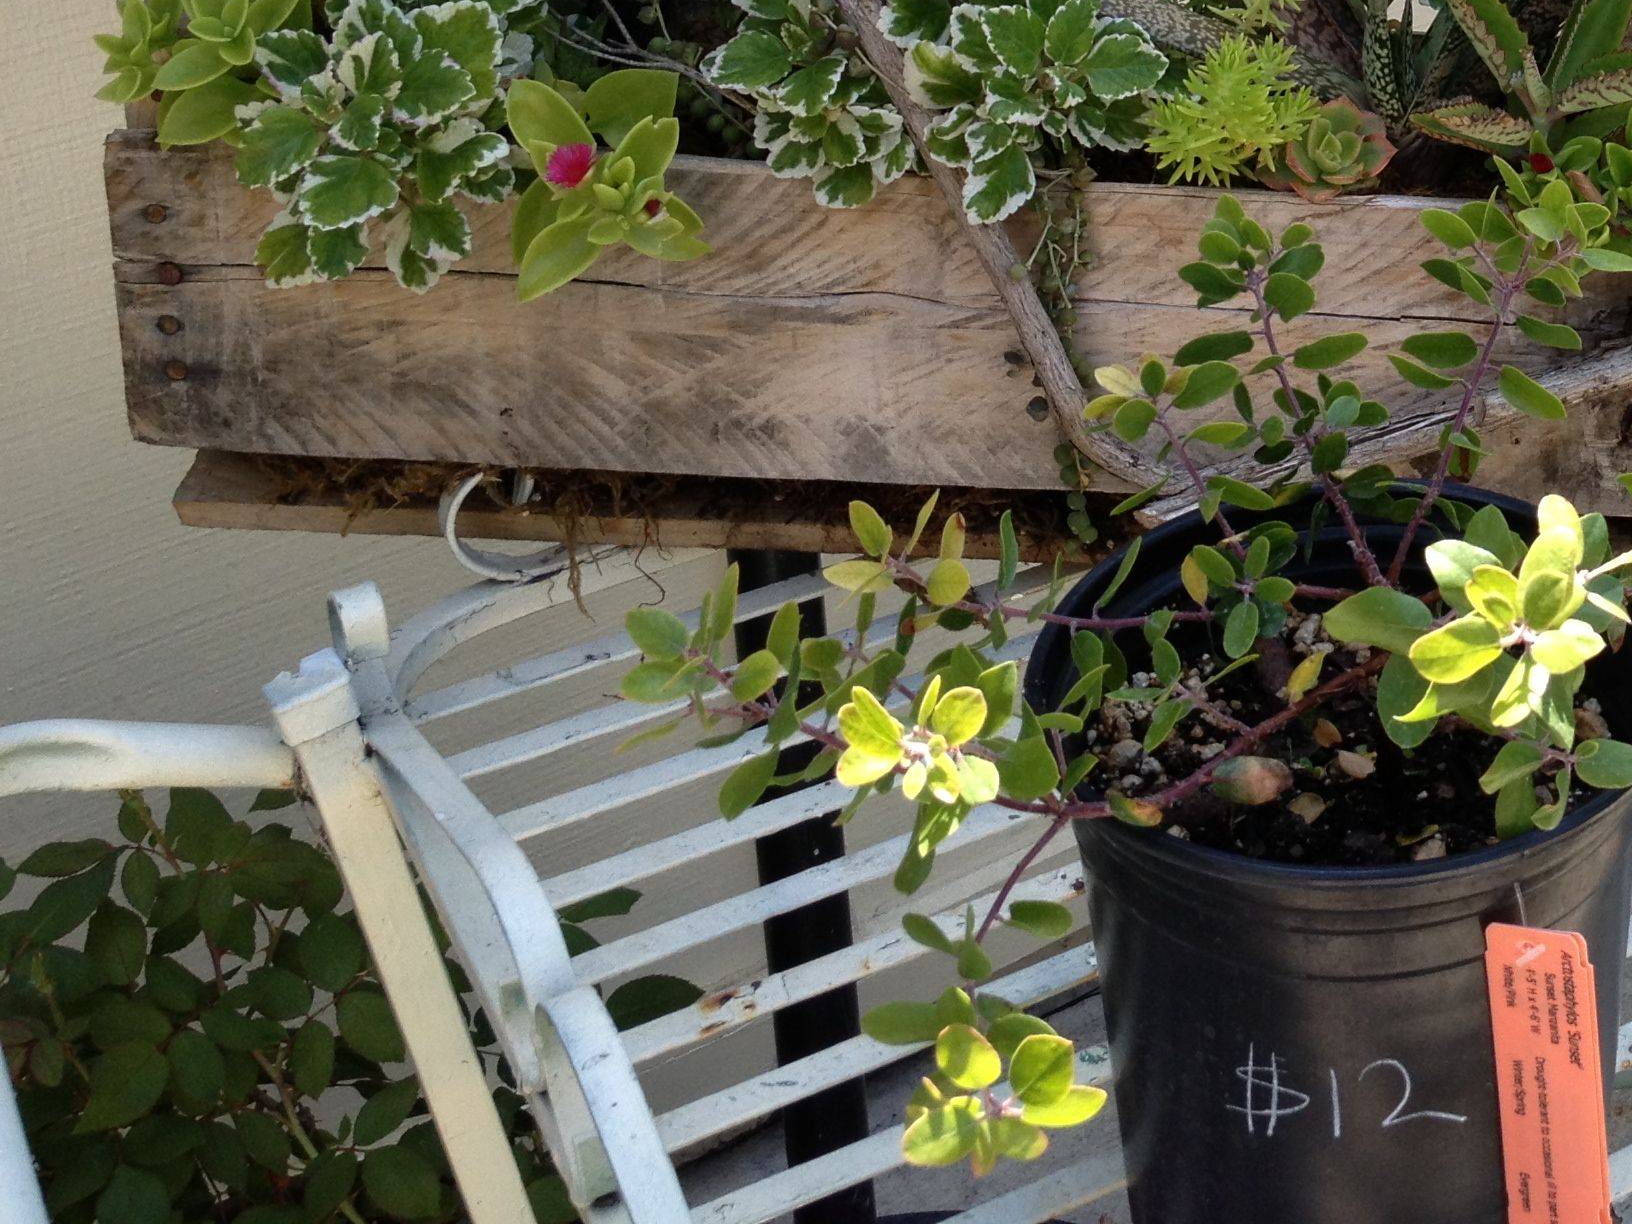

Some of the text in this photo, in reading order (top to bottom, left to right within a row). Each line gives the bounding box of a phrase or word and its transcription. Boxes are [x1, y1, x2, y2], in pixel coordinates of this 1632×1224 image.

[1544, 971, 1561, 1046] Sunset Manzanita
[1225, 1040, 1469, 1138] $12
[1518, 1171, 1532, 1213] Evergreen
